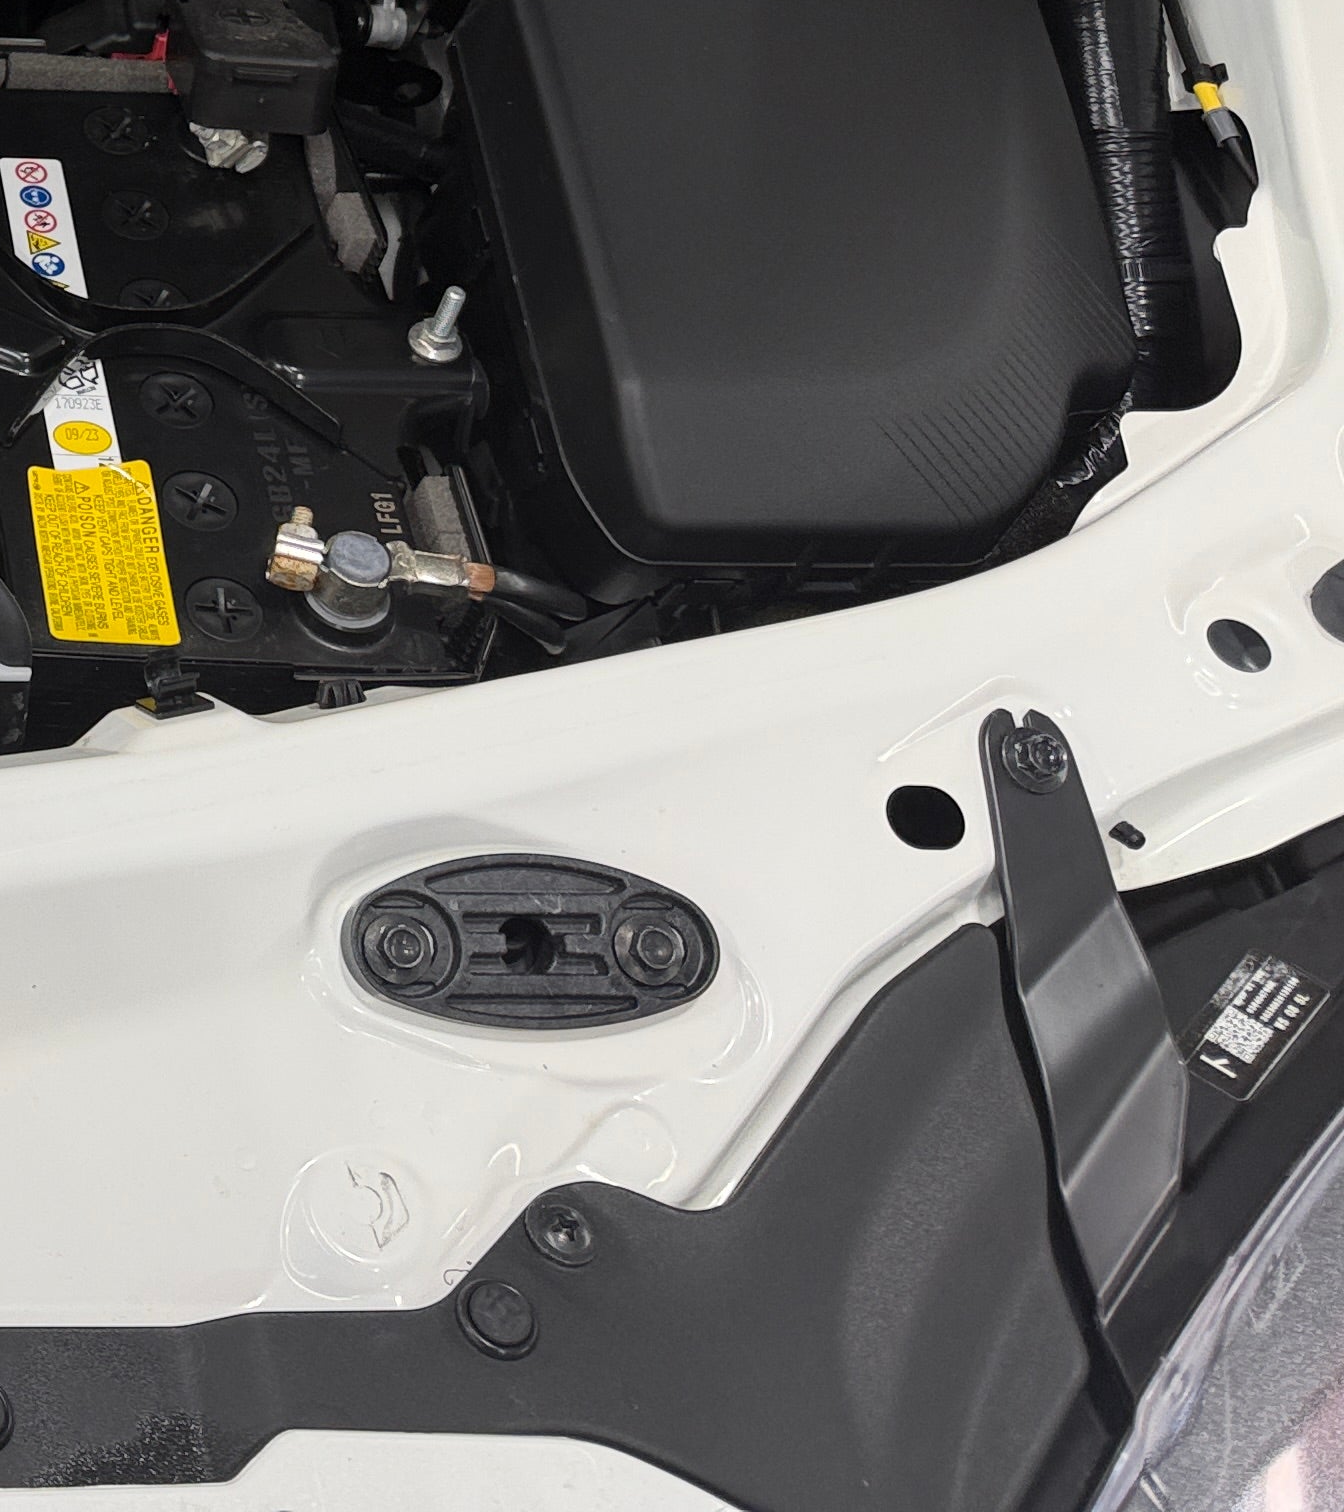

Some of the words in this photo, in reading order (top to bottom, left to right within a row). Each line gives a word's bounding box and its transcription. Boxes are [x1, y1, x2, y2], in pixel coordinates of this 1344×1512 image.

[54, 397, 103, 411] 170923E
[64, 427, 100, 441] 09/23
[46, 513, 58, 529] OUT
[75, 495, 97, 538] POISON
[83, 539, 98, 570] CAUSES
[99, 535, 113, 556] CAPS
[102, 557, 116, 579] TIGHT
[135, 495, 161, 555] DANGER
[153, 598, 170, 626] GASES
